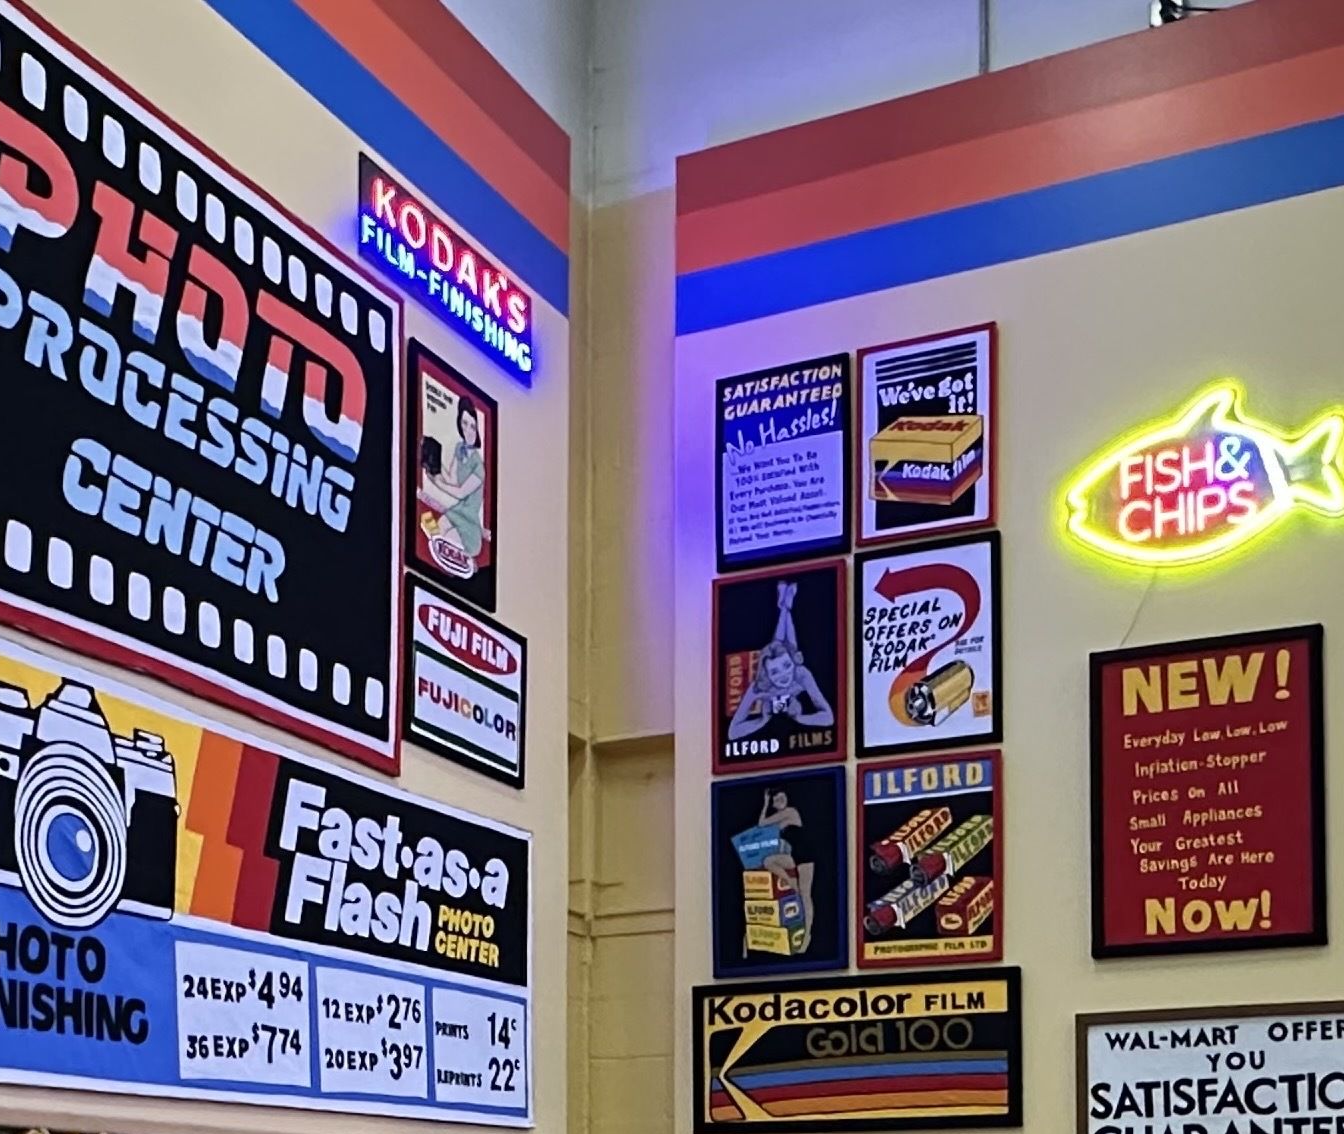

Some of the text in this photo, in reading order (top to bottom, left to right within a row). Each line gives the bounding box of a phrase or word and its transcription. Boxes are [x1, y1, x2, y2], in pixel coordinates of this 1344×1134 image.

[373, 176, 527, 334] KODAK'S
[360, 213, 532, 372] FILM-FINISHING
[722, 362, 843, 404] SATISFACTION
[722, 382, 844, 422] GUARANTEED
[724, 396, 837, 467] No Hassles!
[901, 462, 951, 482] Kodak
[62, 437, 287, 604] CENTER
[1117, 480, 1257, 543] CHIPS
[863, 597, 942, 625] SPECIAL
[864, 612, 963, 642] OFFERS ON
[427, 606, 510, 672] FUJI FILM
[867, 652, 909, 673] FILM
[1121, 649, 1291, 717] NEW!
[418, 676, 517, 742] FUJICOLOR
[725, 730, 834, 757] ILFORD FILMS
[1123, 729, 1186, 749] Everyday
[873, 761, 984, 797] ILFORD
[1134, 750, 1268, 779] Inflation-Stopper
[1132, 780, 1239, 806] Prices All
[907, 810, 950, 852] ILFORD
[1129, 805, 1263, 831] Small Appliances
[1130, 830, 1244, 855] Your Greatest
[1139, 850, 1275, 874] Savings Are Here
[1177, 874, 1227, 892] Today
[284, 852, 433, 952] Flash
[437, 904, 496, 935] PHOTO
[434, 931, 500, 968] CENTER
[707, 990, 985, 1026] Kodacolor FILM
[435, 1020, 469, 1041] PRINTS
[894, 1016, 974, 1051] 100
[1104, 1024, 1240, 1051] WAL-MART
[1206, 1049, 1266, 1073] YOU
